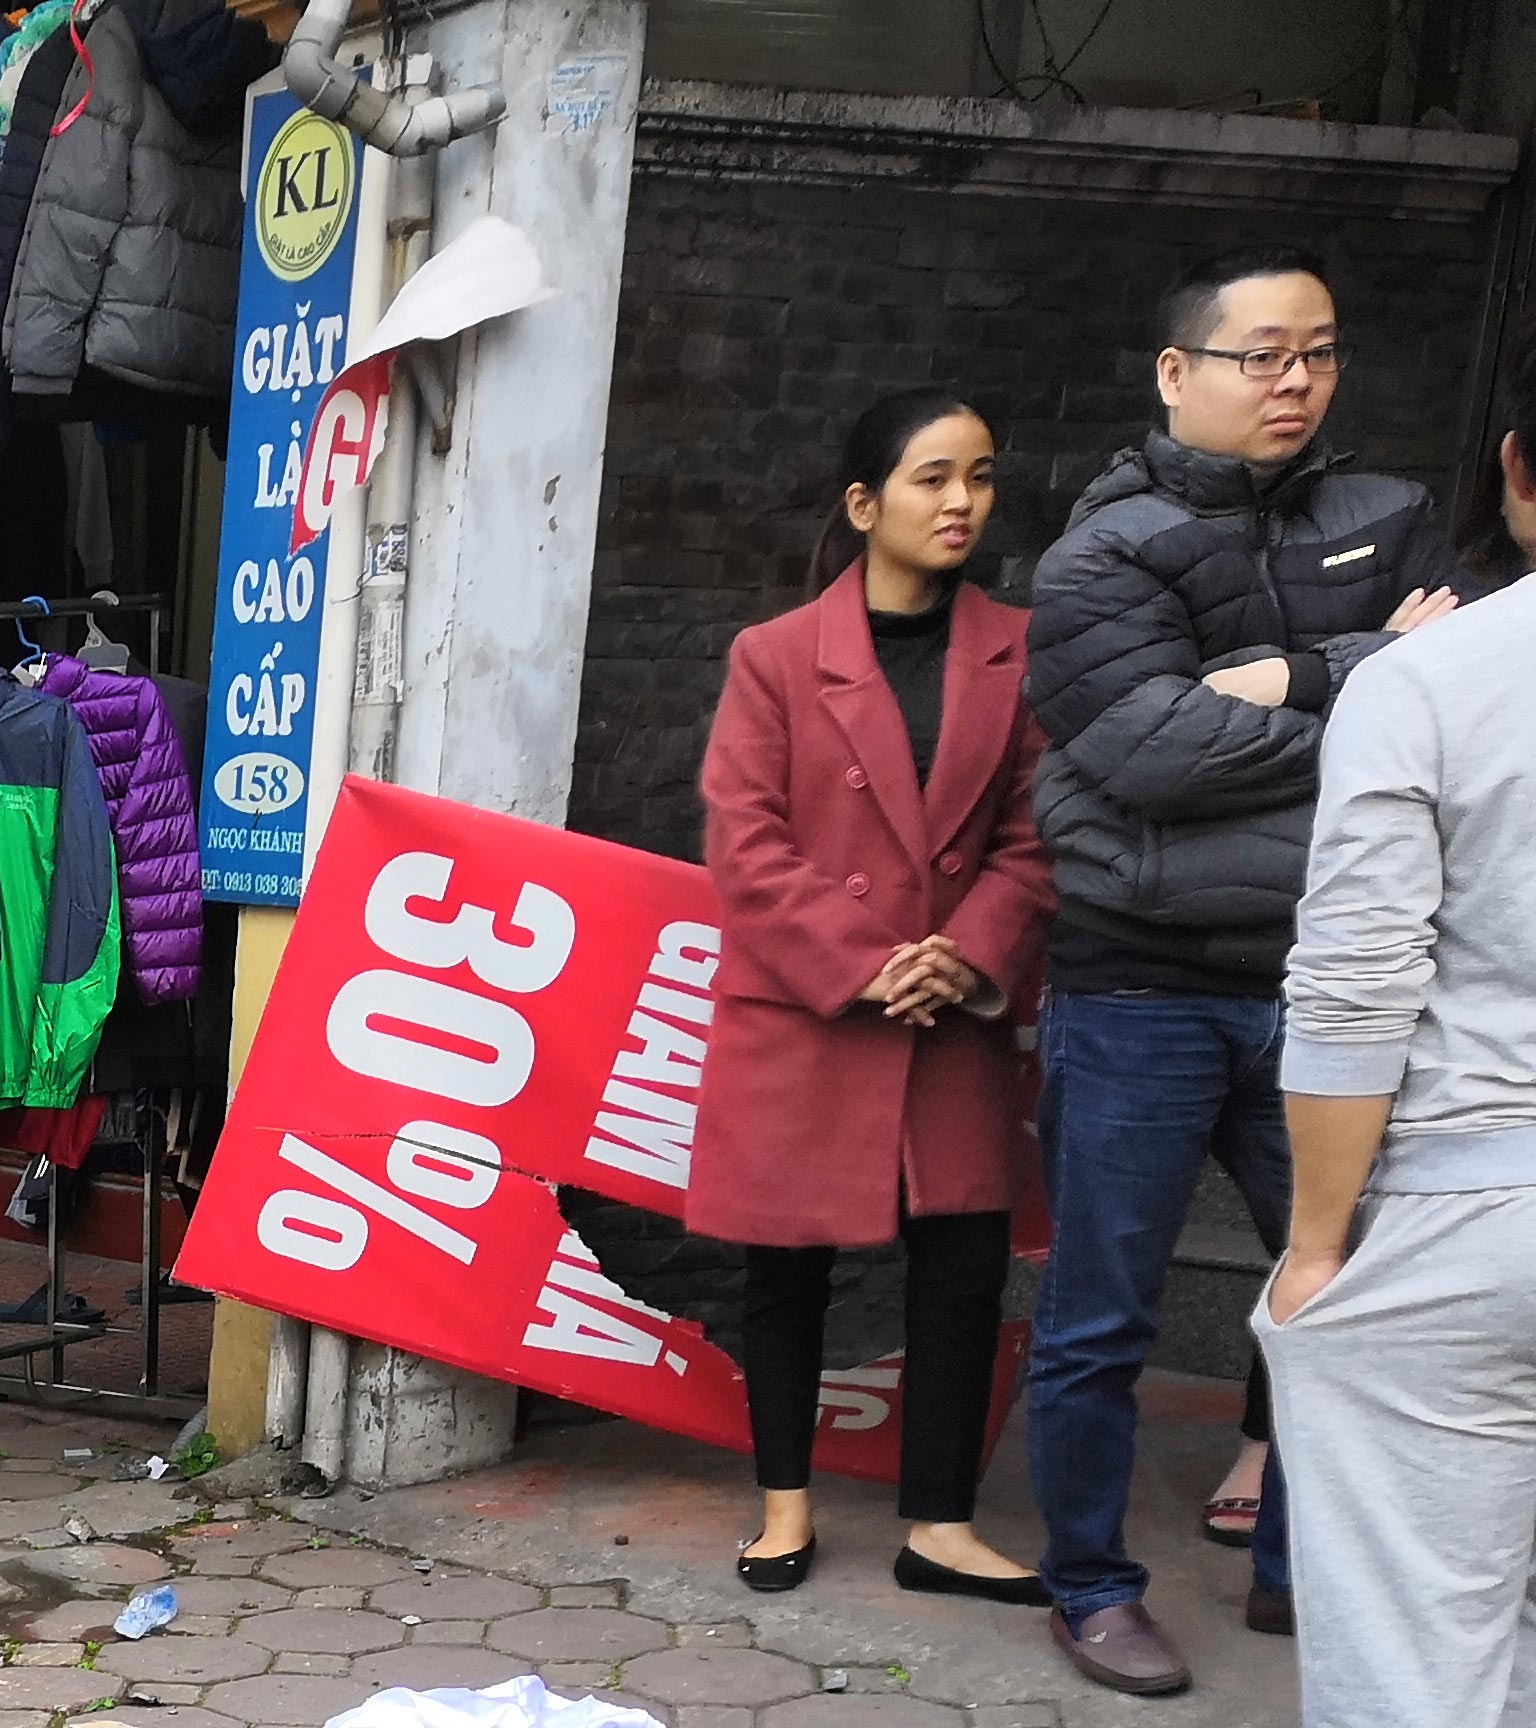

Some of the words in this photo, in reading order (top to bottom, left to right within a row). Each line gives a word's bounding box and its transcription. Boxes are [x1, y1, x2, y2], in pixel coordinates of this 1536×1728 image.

[272, 146, 339, 219] KL
[242, 301, 343, 403] GIẶT
[254, 420, 303, 509] LÀ
[232, 556, 314, 623] CAO
[226, 641, 306, 736] CẤP
[231, 764, 289, 804] 158
[207, 826, 248, 854] NGỌC
[250, 825, 304, 854] KHÁNH
[224, 871, 252, 892] 0913
[255, 874, 278, 895] 038
